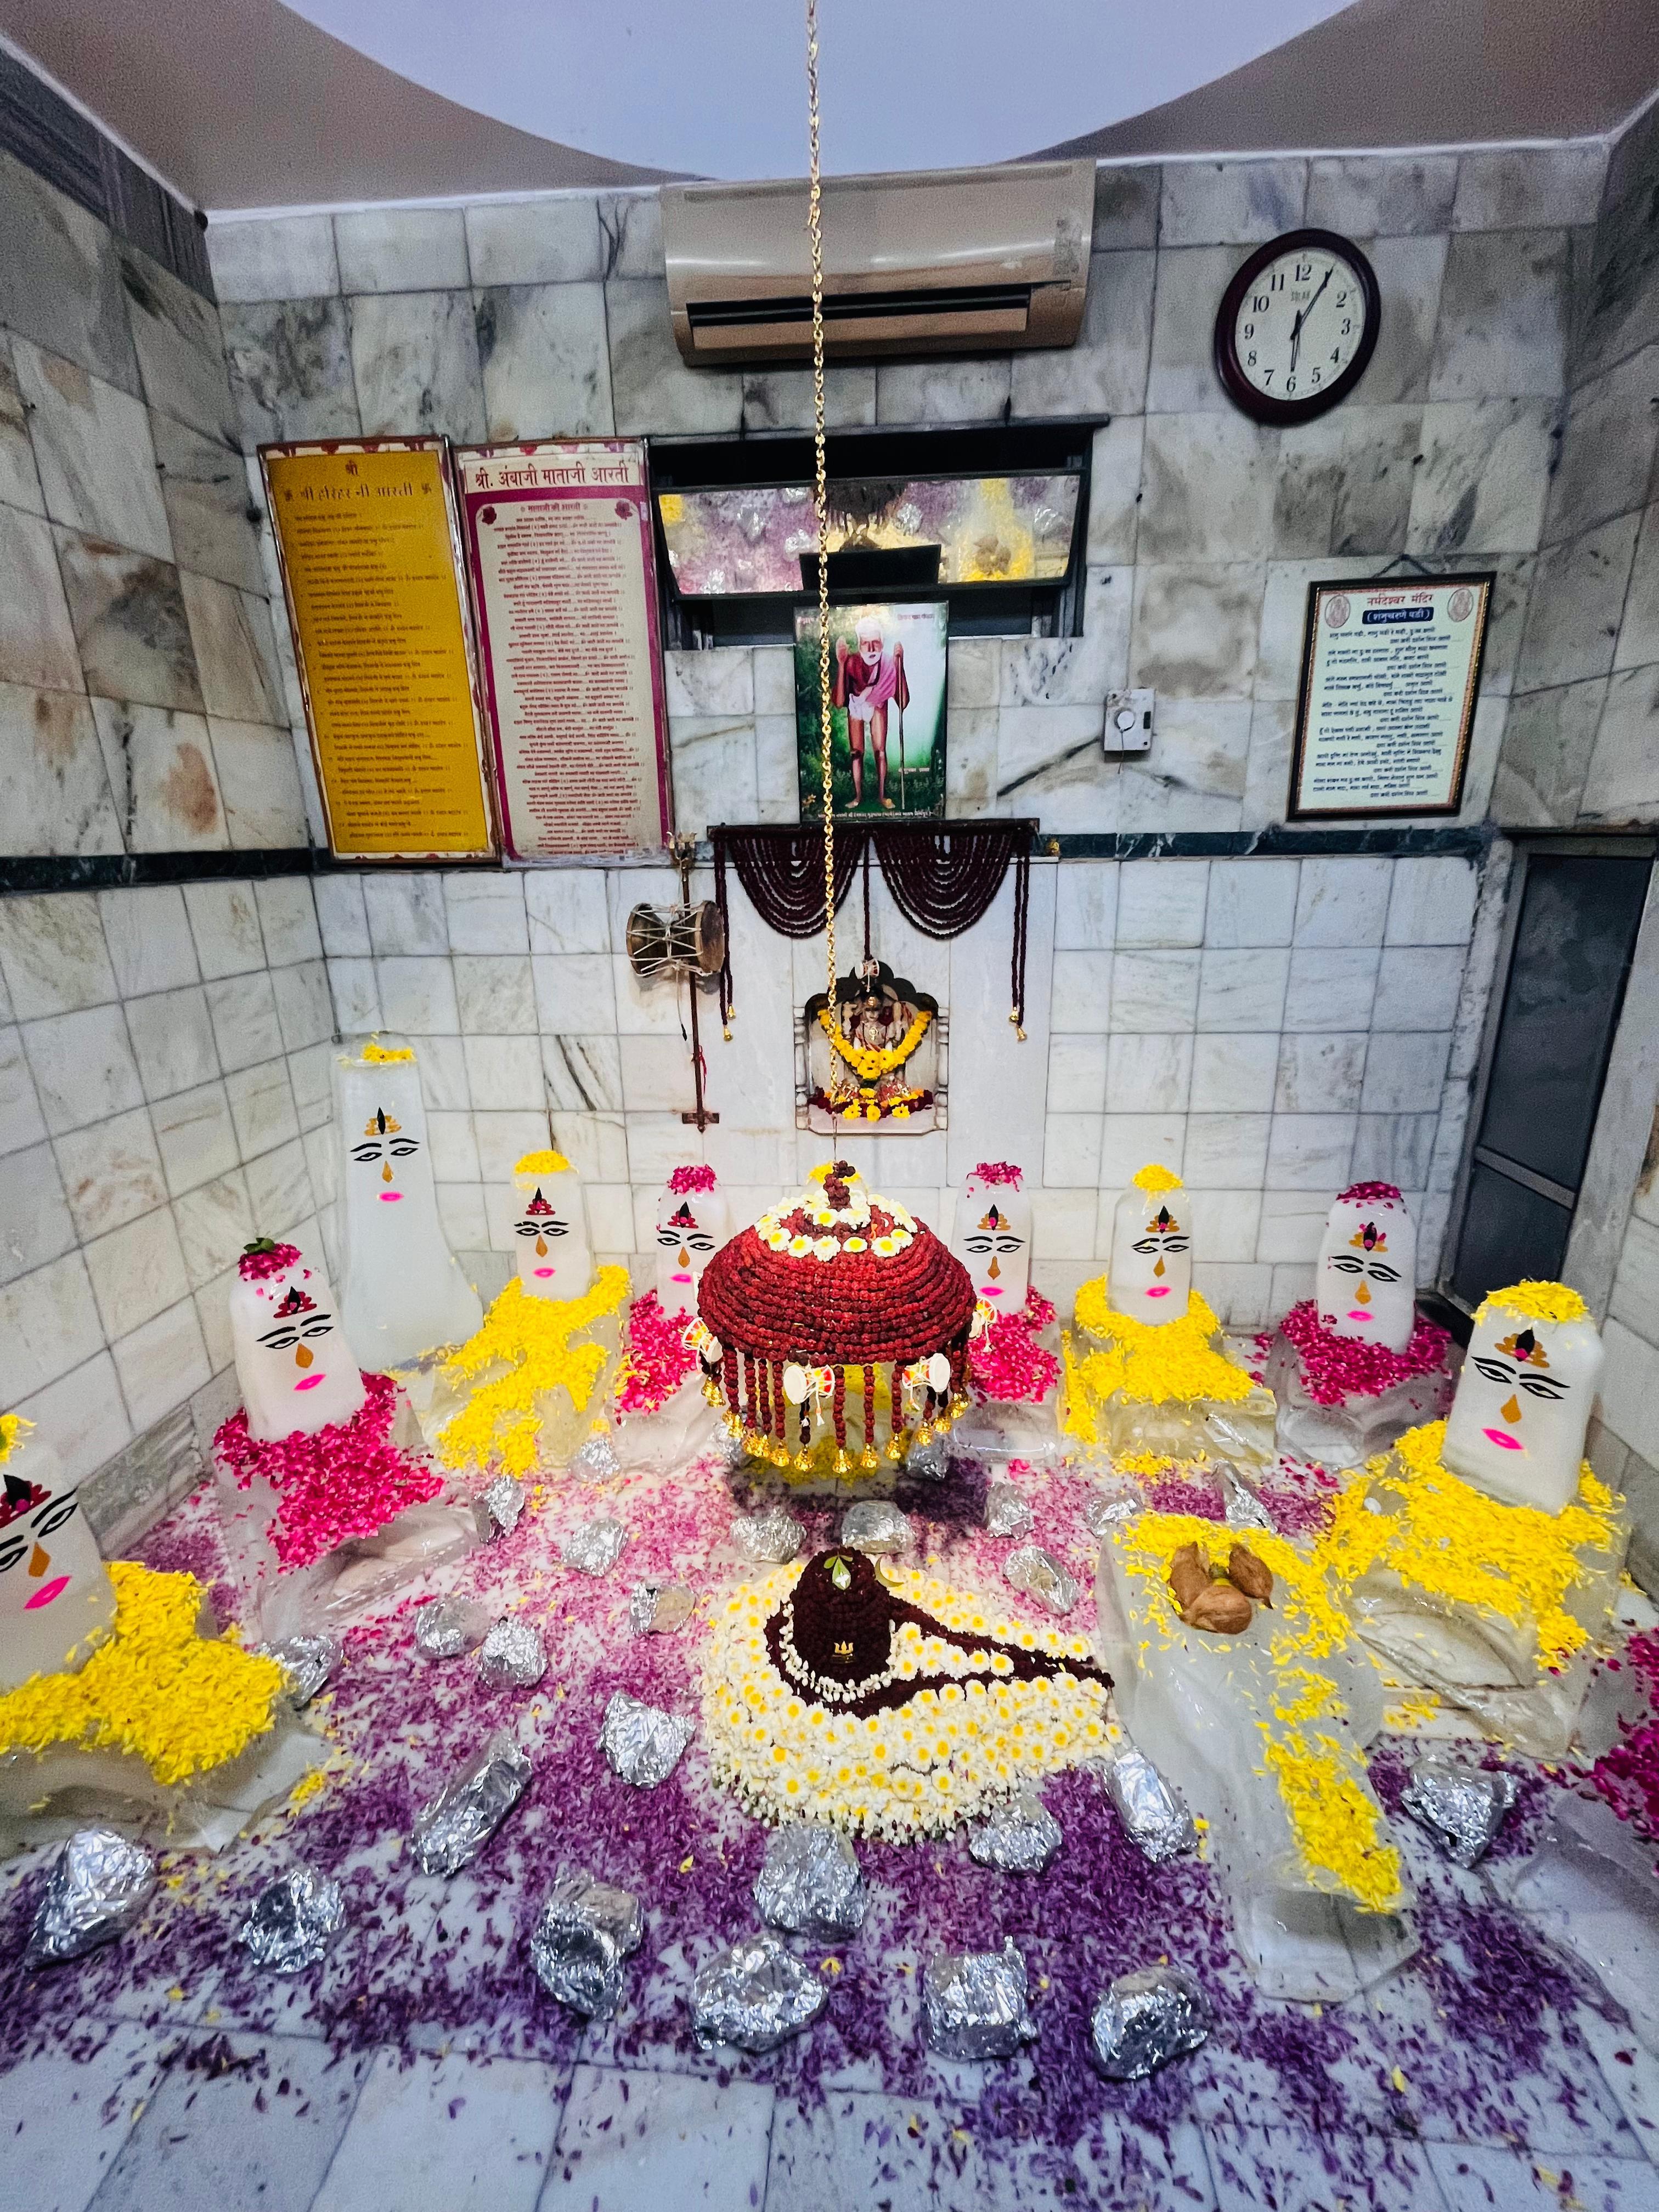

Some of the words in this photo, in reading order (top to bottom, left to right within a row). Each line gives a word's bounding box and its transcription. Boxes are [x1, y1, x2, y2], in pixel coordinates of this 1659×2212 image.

[1295, 264, 1312, 282] 12
[1271, 273, 1285, 291] 11
[1253, 296, 1270, 313] 10
[1336, 290, 1347, 308] 2
[1244, 324, 1255, 340] 9
[1341, 318, 1351, 335] 3
[1248, 350, 1257, 366] 8
[1330, 347, 1340, 364] 4
[1264, 369, 1276, 386] 7
[1311, 366, 1321, 383] 5
[1286, 376, 1296, 393] 6
[498, 463, 539, 488] अंबाजी
[541, 461, 586, 486] माताजी
[591, 460, 630, 484] आरती
